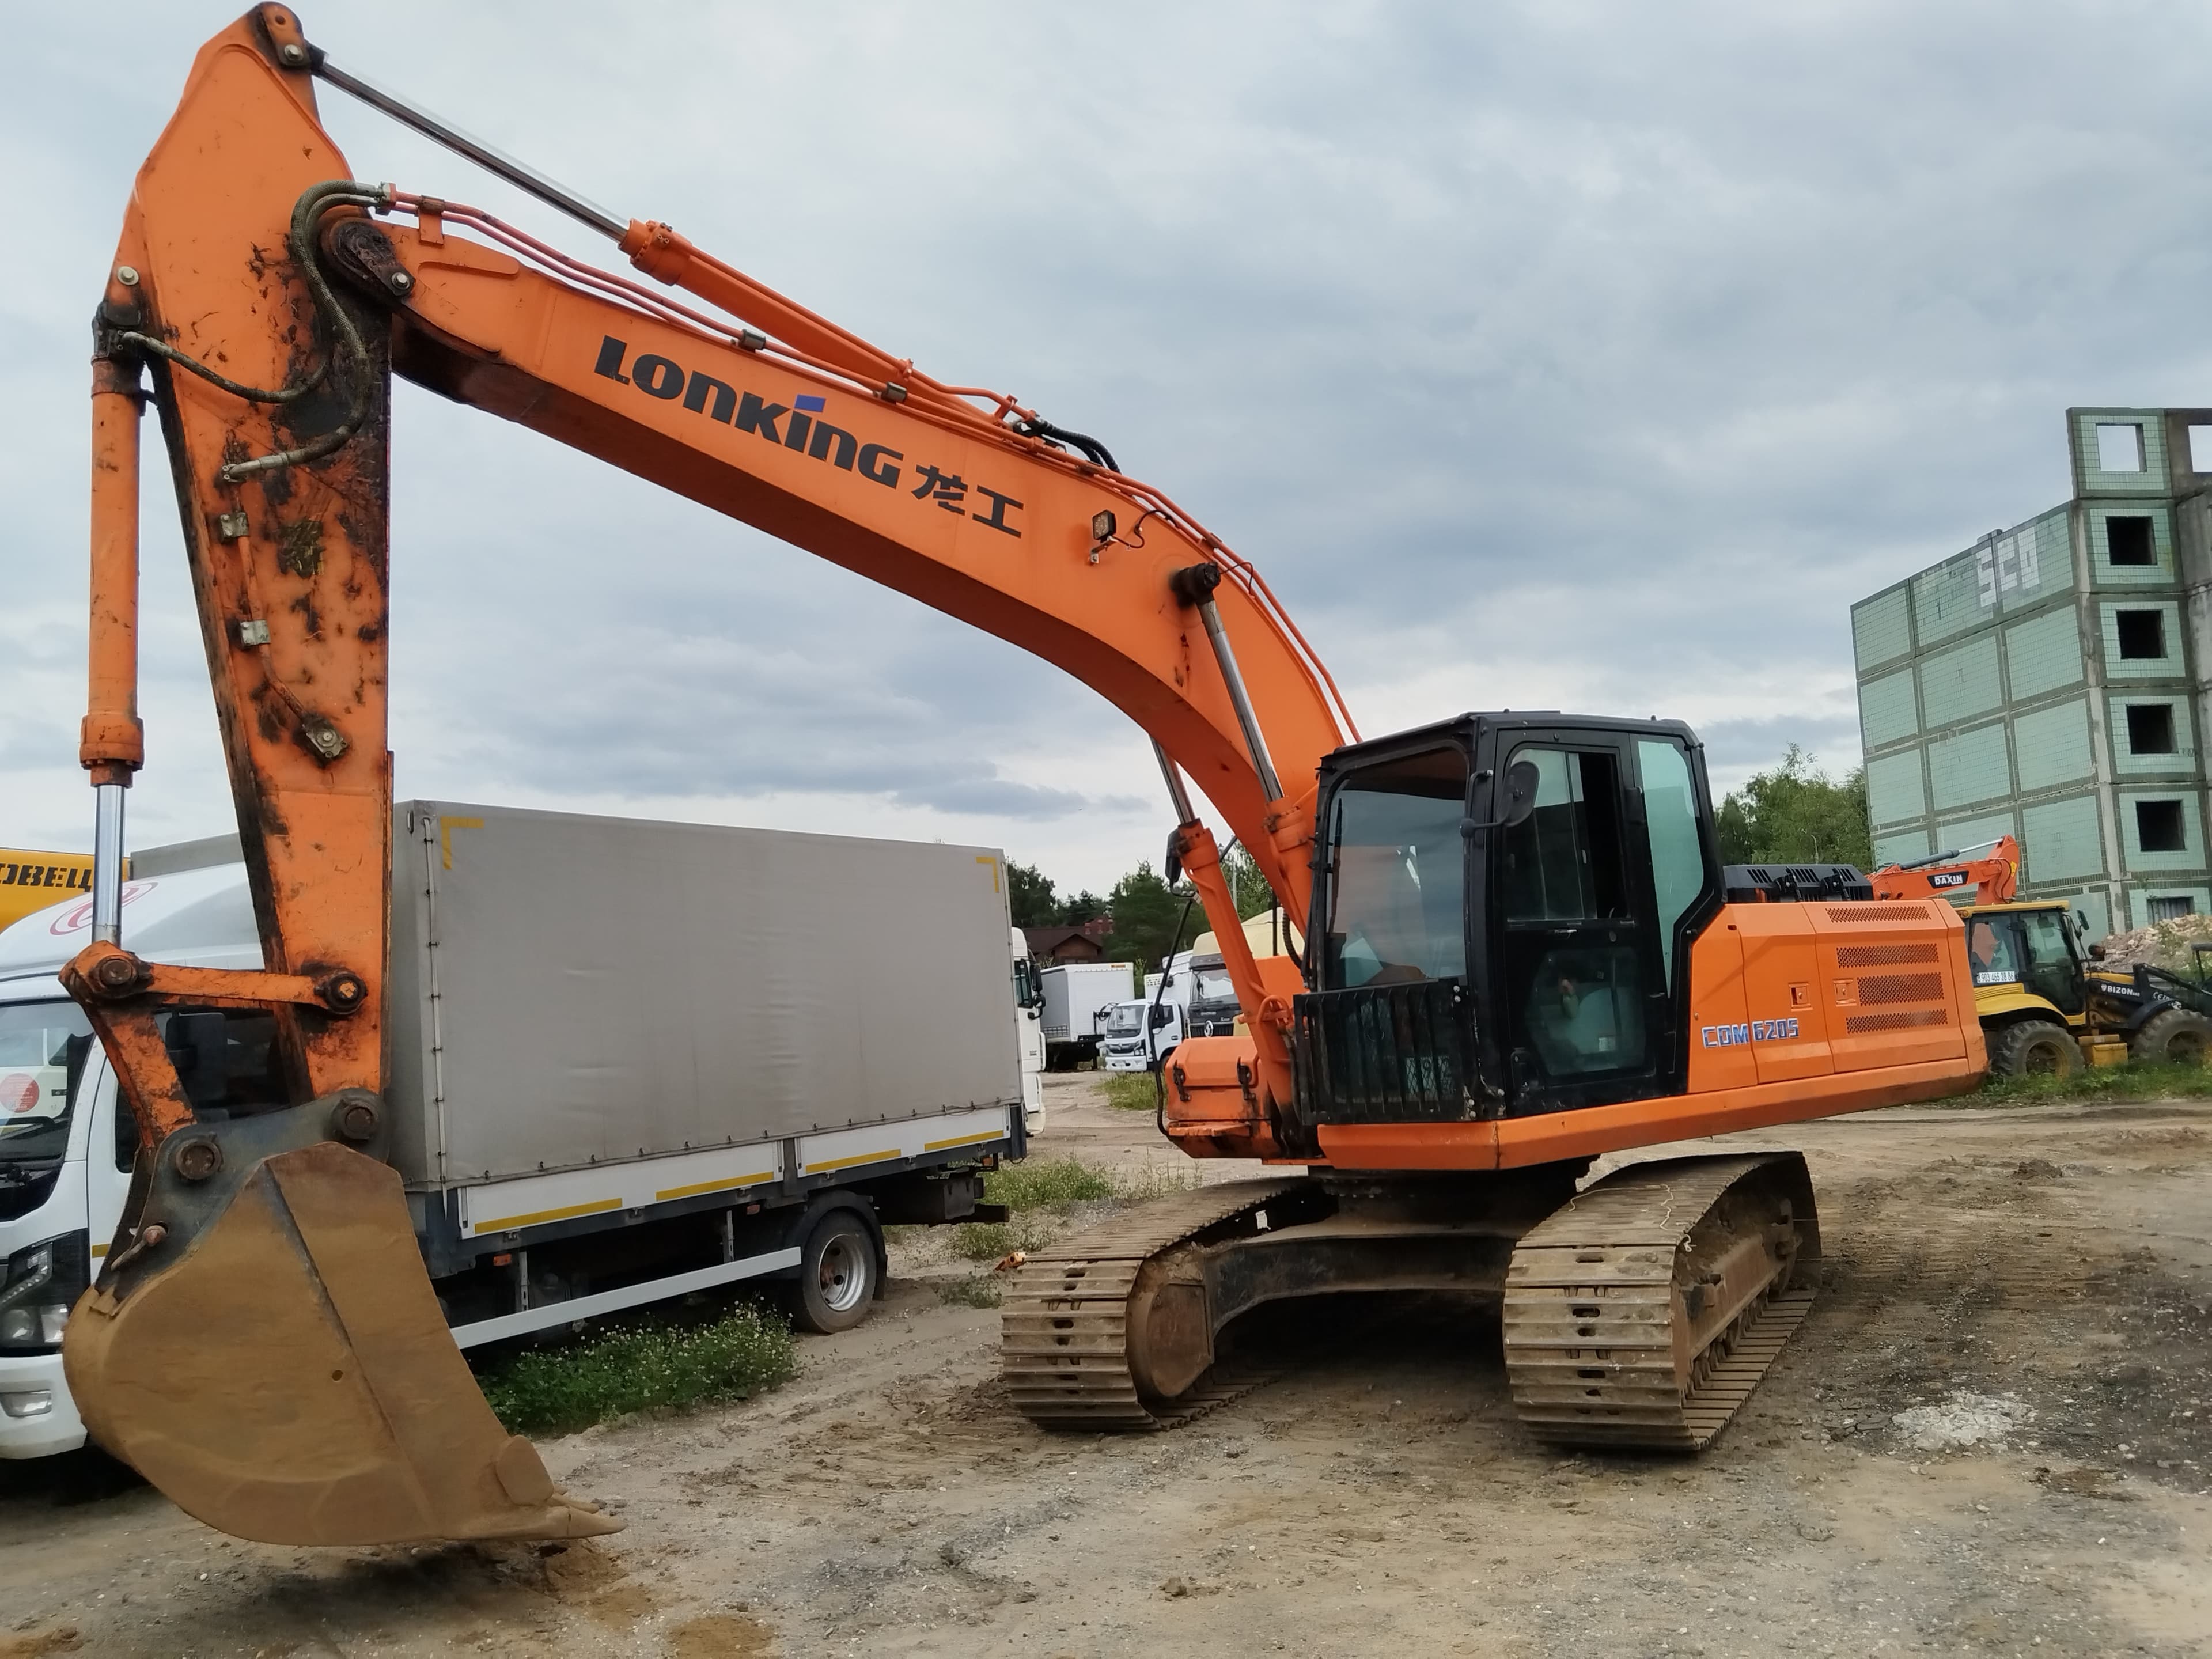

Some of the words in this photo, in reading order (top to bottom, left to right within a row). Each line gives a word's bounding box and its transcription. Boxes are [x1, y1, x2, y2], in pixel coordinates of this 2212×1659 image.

[1934, 875, 1963, 885] DAXIN
[1982, 972, 1990, 982] 903
[2107, 986, 2133, 996] BIZON
